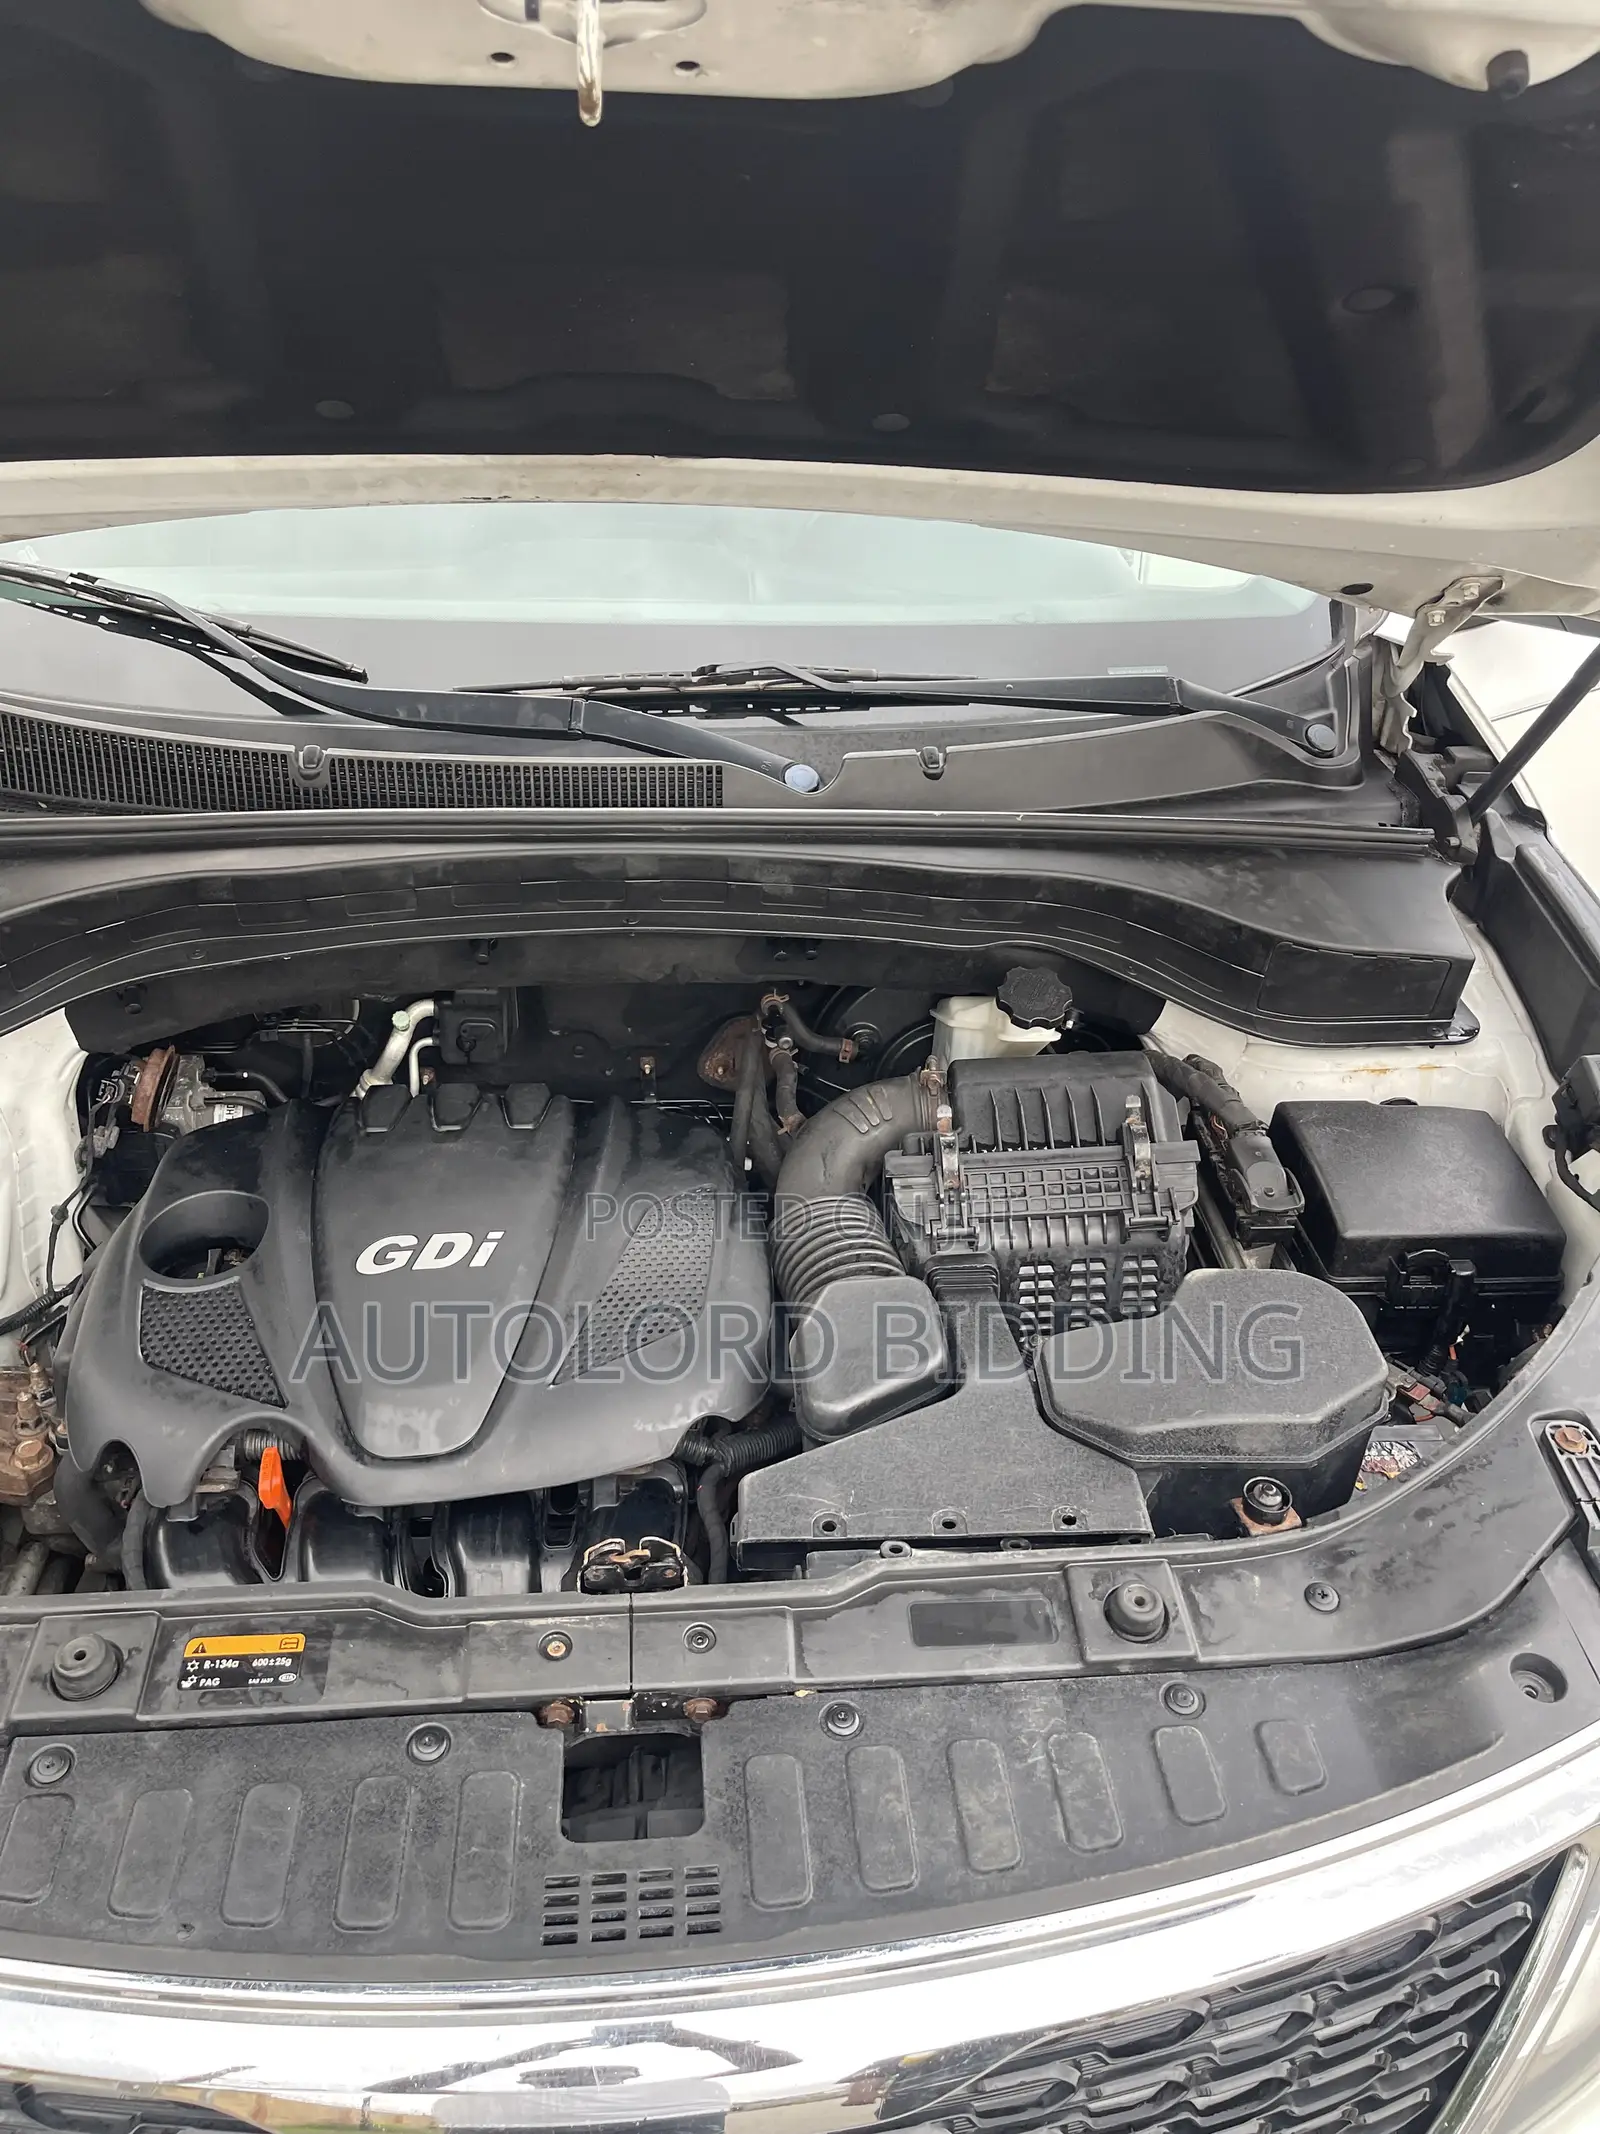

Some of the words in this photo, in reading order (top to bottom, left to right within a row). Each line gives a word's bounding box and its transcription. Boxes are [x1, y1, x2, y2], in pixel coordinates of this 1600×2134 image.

[355, 1230, 506, 1275] GDi
[203, 1659, 239, 1669] R-134a
[252, 1657, 292, 1667] 600±25g
[199, 1678, 220, 1687] PAG
